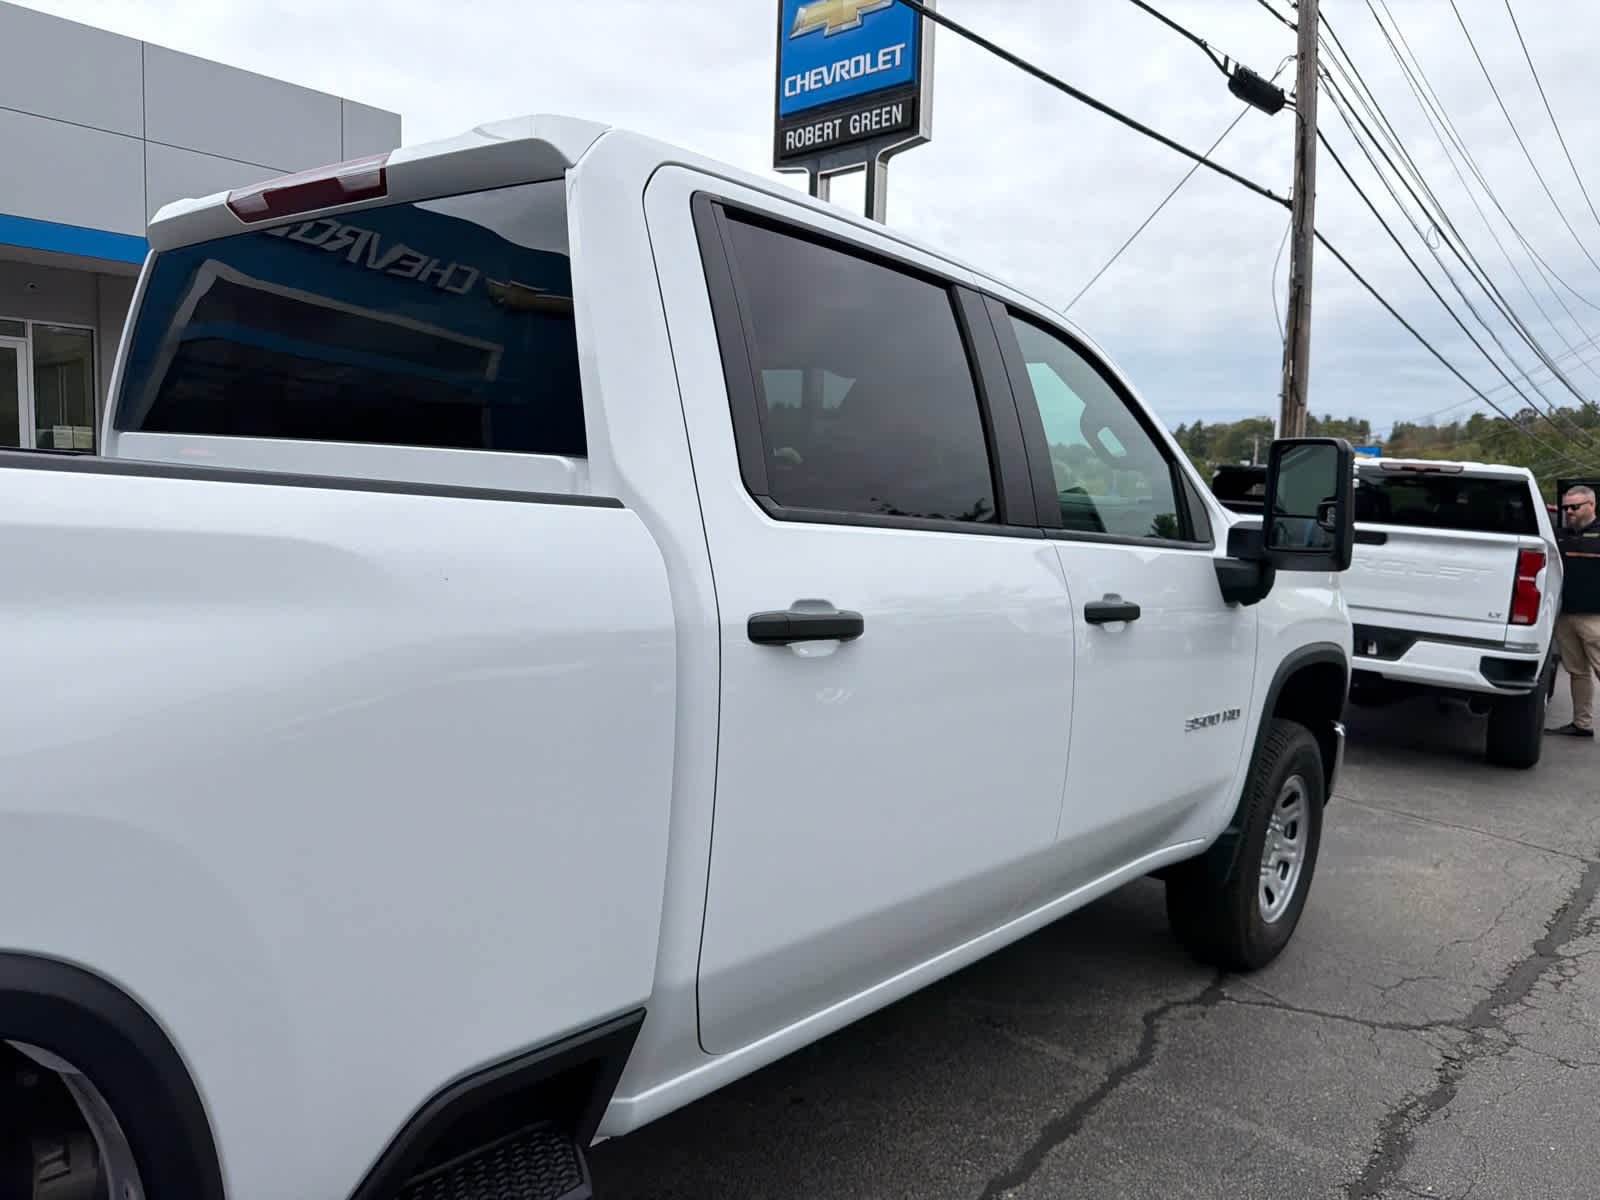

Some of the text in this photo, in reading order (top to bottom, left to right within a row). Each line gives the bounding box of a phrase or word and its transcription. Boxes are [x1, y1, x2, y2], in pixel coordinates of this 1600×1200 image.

[785, 43, 905, 97] CHEVROLET
[786, 103, 902, 150] ROBERT GREEN
[1184, 712, 1220, 732] 3500
